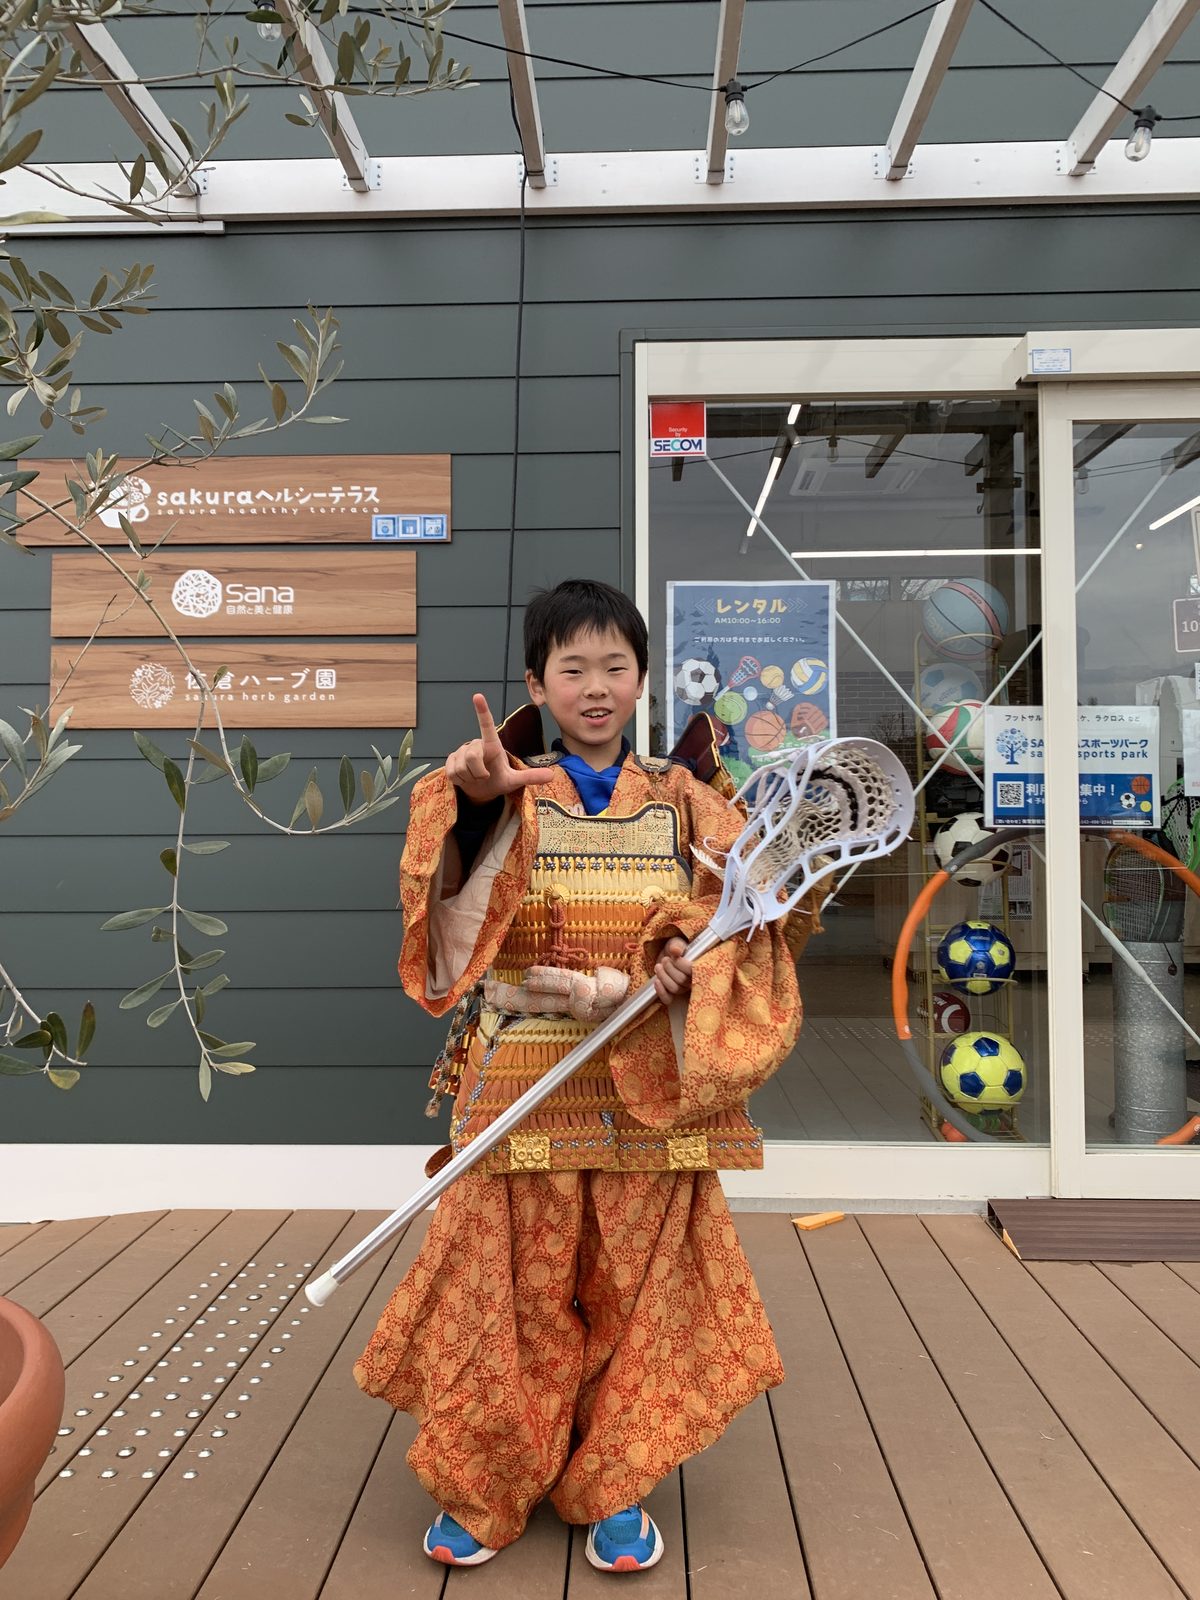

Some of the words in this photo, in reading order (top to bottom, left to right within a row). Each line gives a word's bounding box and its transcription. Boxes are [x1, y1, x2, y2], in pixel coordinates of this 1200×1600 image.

[654, 439, 702, 451] SECOM
[157, 507, 217, 515] sakura
[228, 506, 299, 515] healthy
[310, 506, 380, 514] terrace
[226, 583, 294, 603] Sana
[717, 599, 788, 615] レンタル
[242, 692, 275, 701] herb
[284, 692, 335, 703] garden
[1078, 738, 1148, 749] スポーツパーク
[1121, 749, 1148, 760] park
